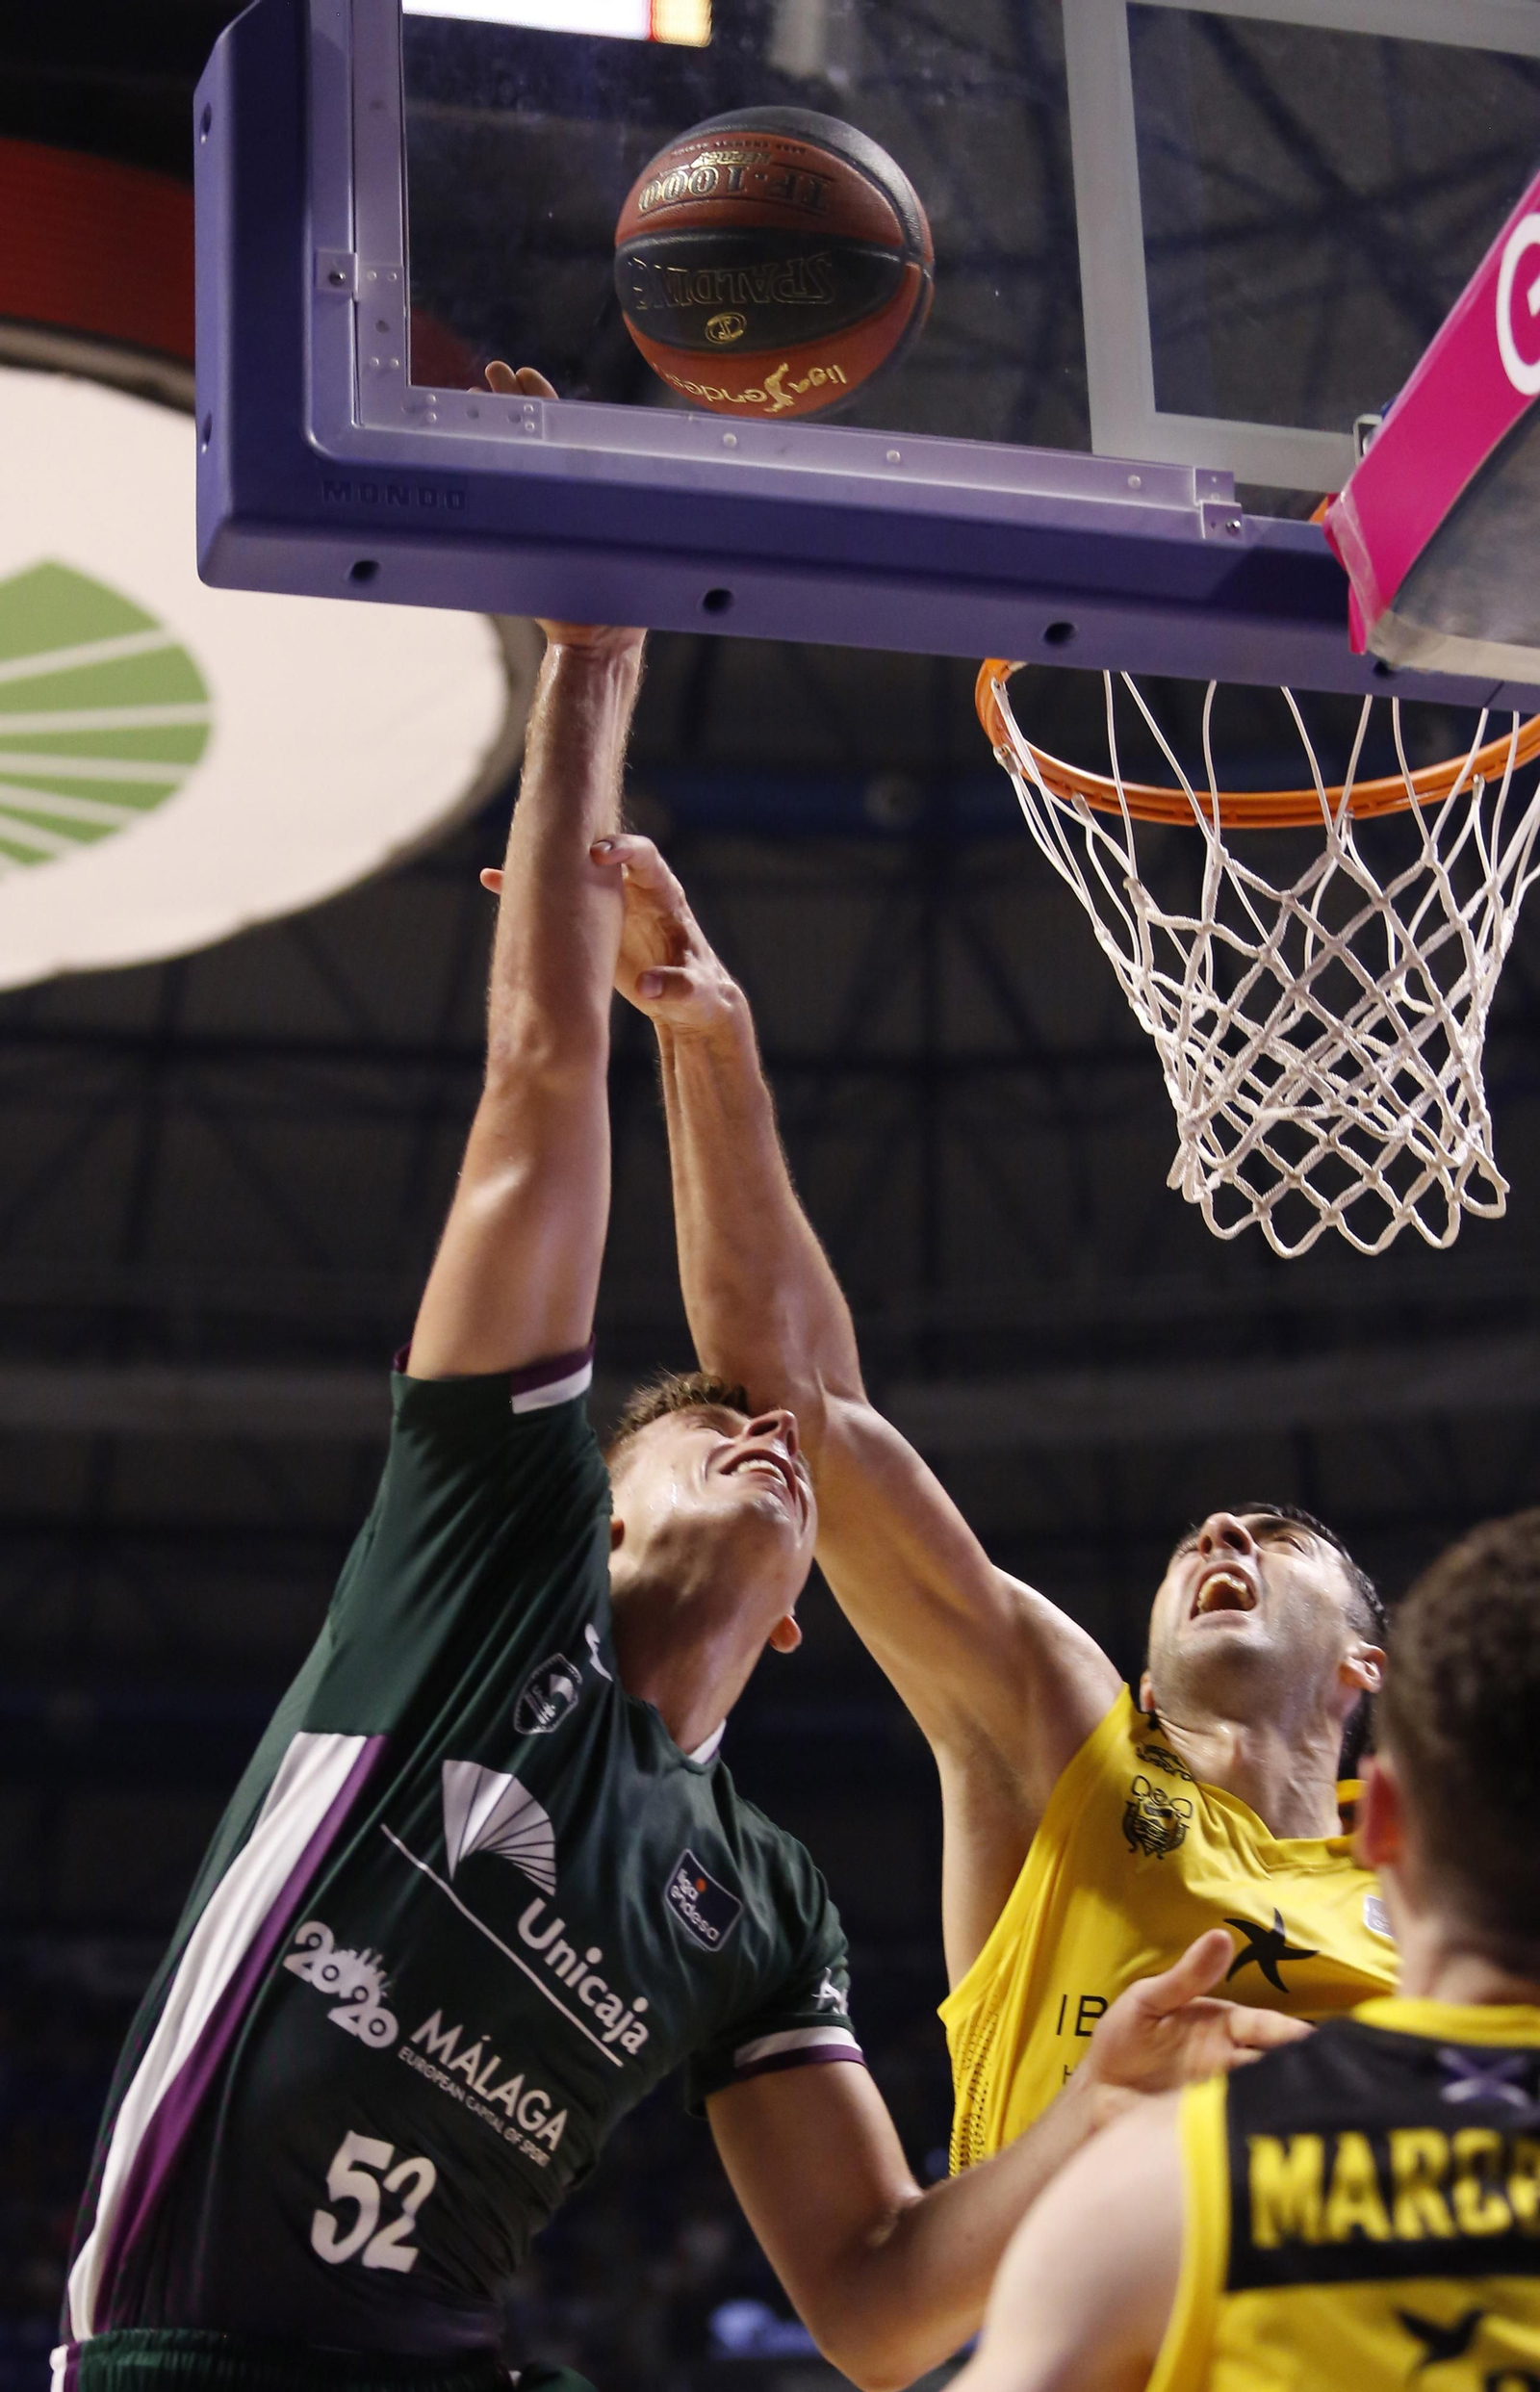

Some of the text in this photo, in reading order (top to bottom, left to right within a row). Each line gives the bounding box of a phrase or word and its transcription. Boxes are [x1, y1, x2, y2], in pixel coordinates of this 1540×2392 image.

[788, 364, 848, 396] liga
[321, 481, 467, 510] MONDO
[671, 1886, 720, 1942] endesa
[282, 1919, 399, 2049] 2020
[518, 1897, 650, 2055] Unicaja
[398, 2045, 467, 2103] EUROPEAN
[503, 2126, 525, 2146] OF
[410, 2008, 568, 2152] MÁLAGA
[311, 2130, 436, 2274] 52
